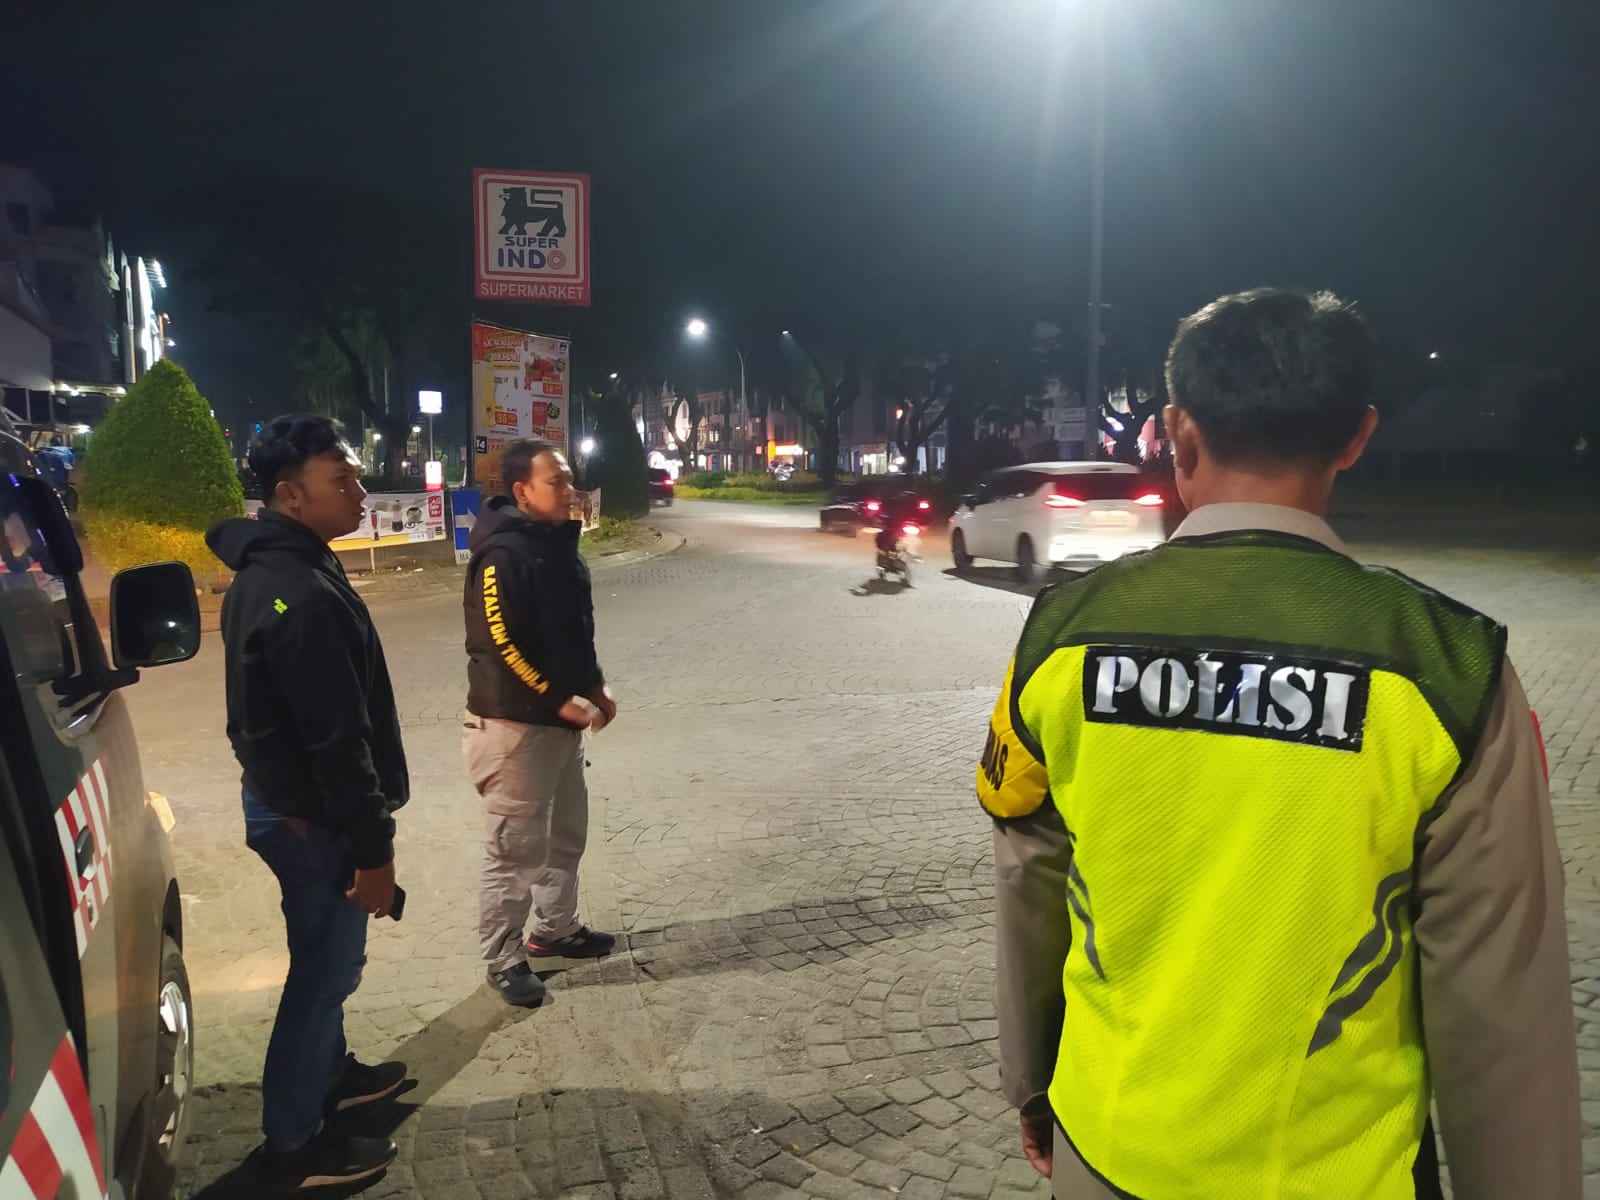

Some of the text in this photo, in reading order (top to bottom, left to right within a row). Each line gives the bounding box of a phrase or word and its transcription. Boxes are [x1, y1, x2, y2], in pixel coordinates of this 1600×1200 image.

[504, 236, 559, 249] SUPER
[497, 247, 567, 271] INDO
[480, 282, 585, 300] SUPERMARKET
[483, 565, 511, 645] BATALYON
[1092, 655, 1356, 741] POLISI
